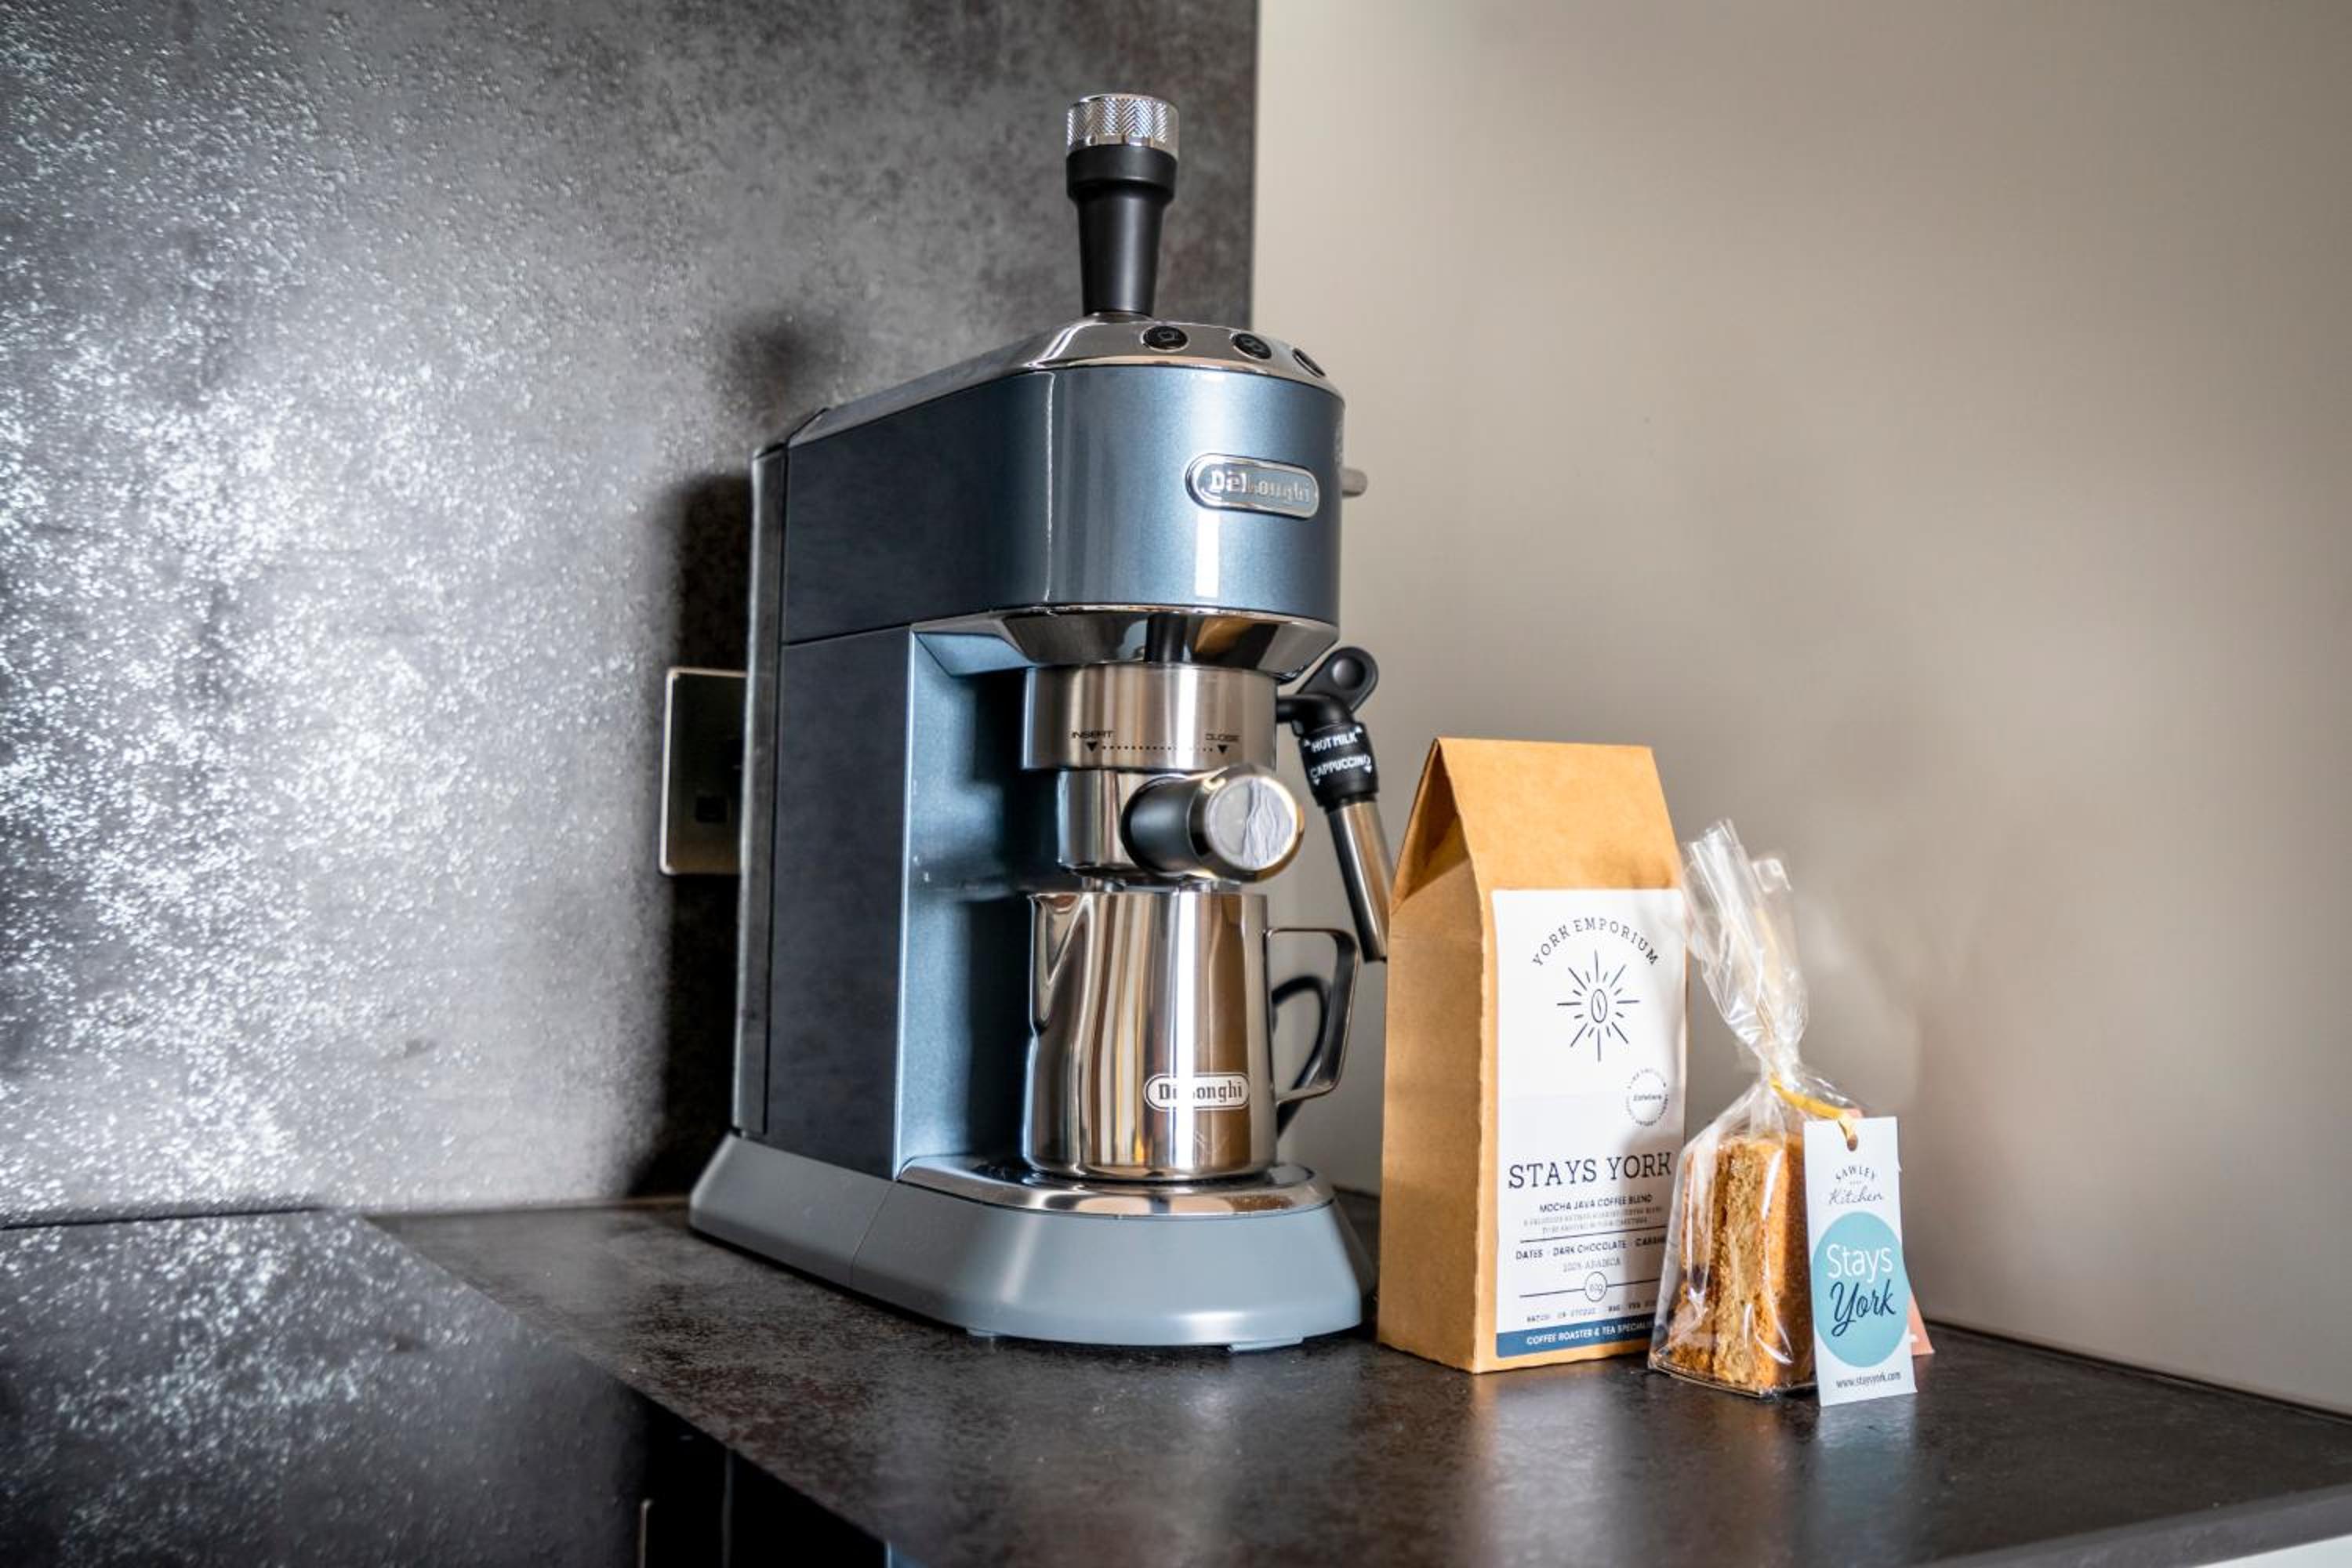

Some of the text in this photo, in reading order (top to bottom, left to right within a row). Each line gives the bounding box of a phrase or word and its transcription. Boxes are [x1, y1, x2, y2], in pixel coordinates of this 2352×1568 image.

[1205, 733, 1240, 742] CLOSE
[1312, 731, 1357, 753] HOT MILK
[1310, 753, 1371, 779] CAPPUCCINO
[1532, 917, 1659, 967] YORK EMPORIUM
[1508, 1152, 1672, 1189] STAYS YORK
[1539, 1193, 1653, 1213] MOCHA JAVA COFFEE BLEND
[1828, 1187, 1883, 1206] Kitchen
[1515, 1249, 1543, 1261] DATES
[1553, 1246, 1575, 1257] DARK
[1577, 1241, 1627, 1254] CHOCOLATE
[1827, 1243, 1893, 1283] Stays
[1830, 1279, 1896, 1337] York
[1526, 1334, 1556, 1345] COFFEE
[1558, 1329, 1593, 1341] ROASTER
[1602, 1325, 1616, 1335] TEA
